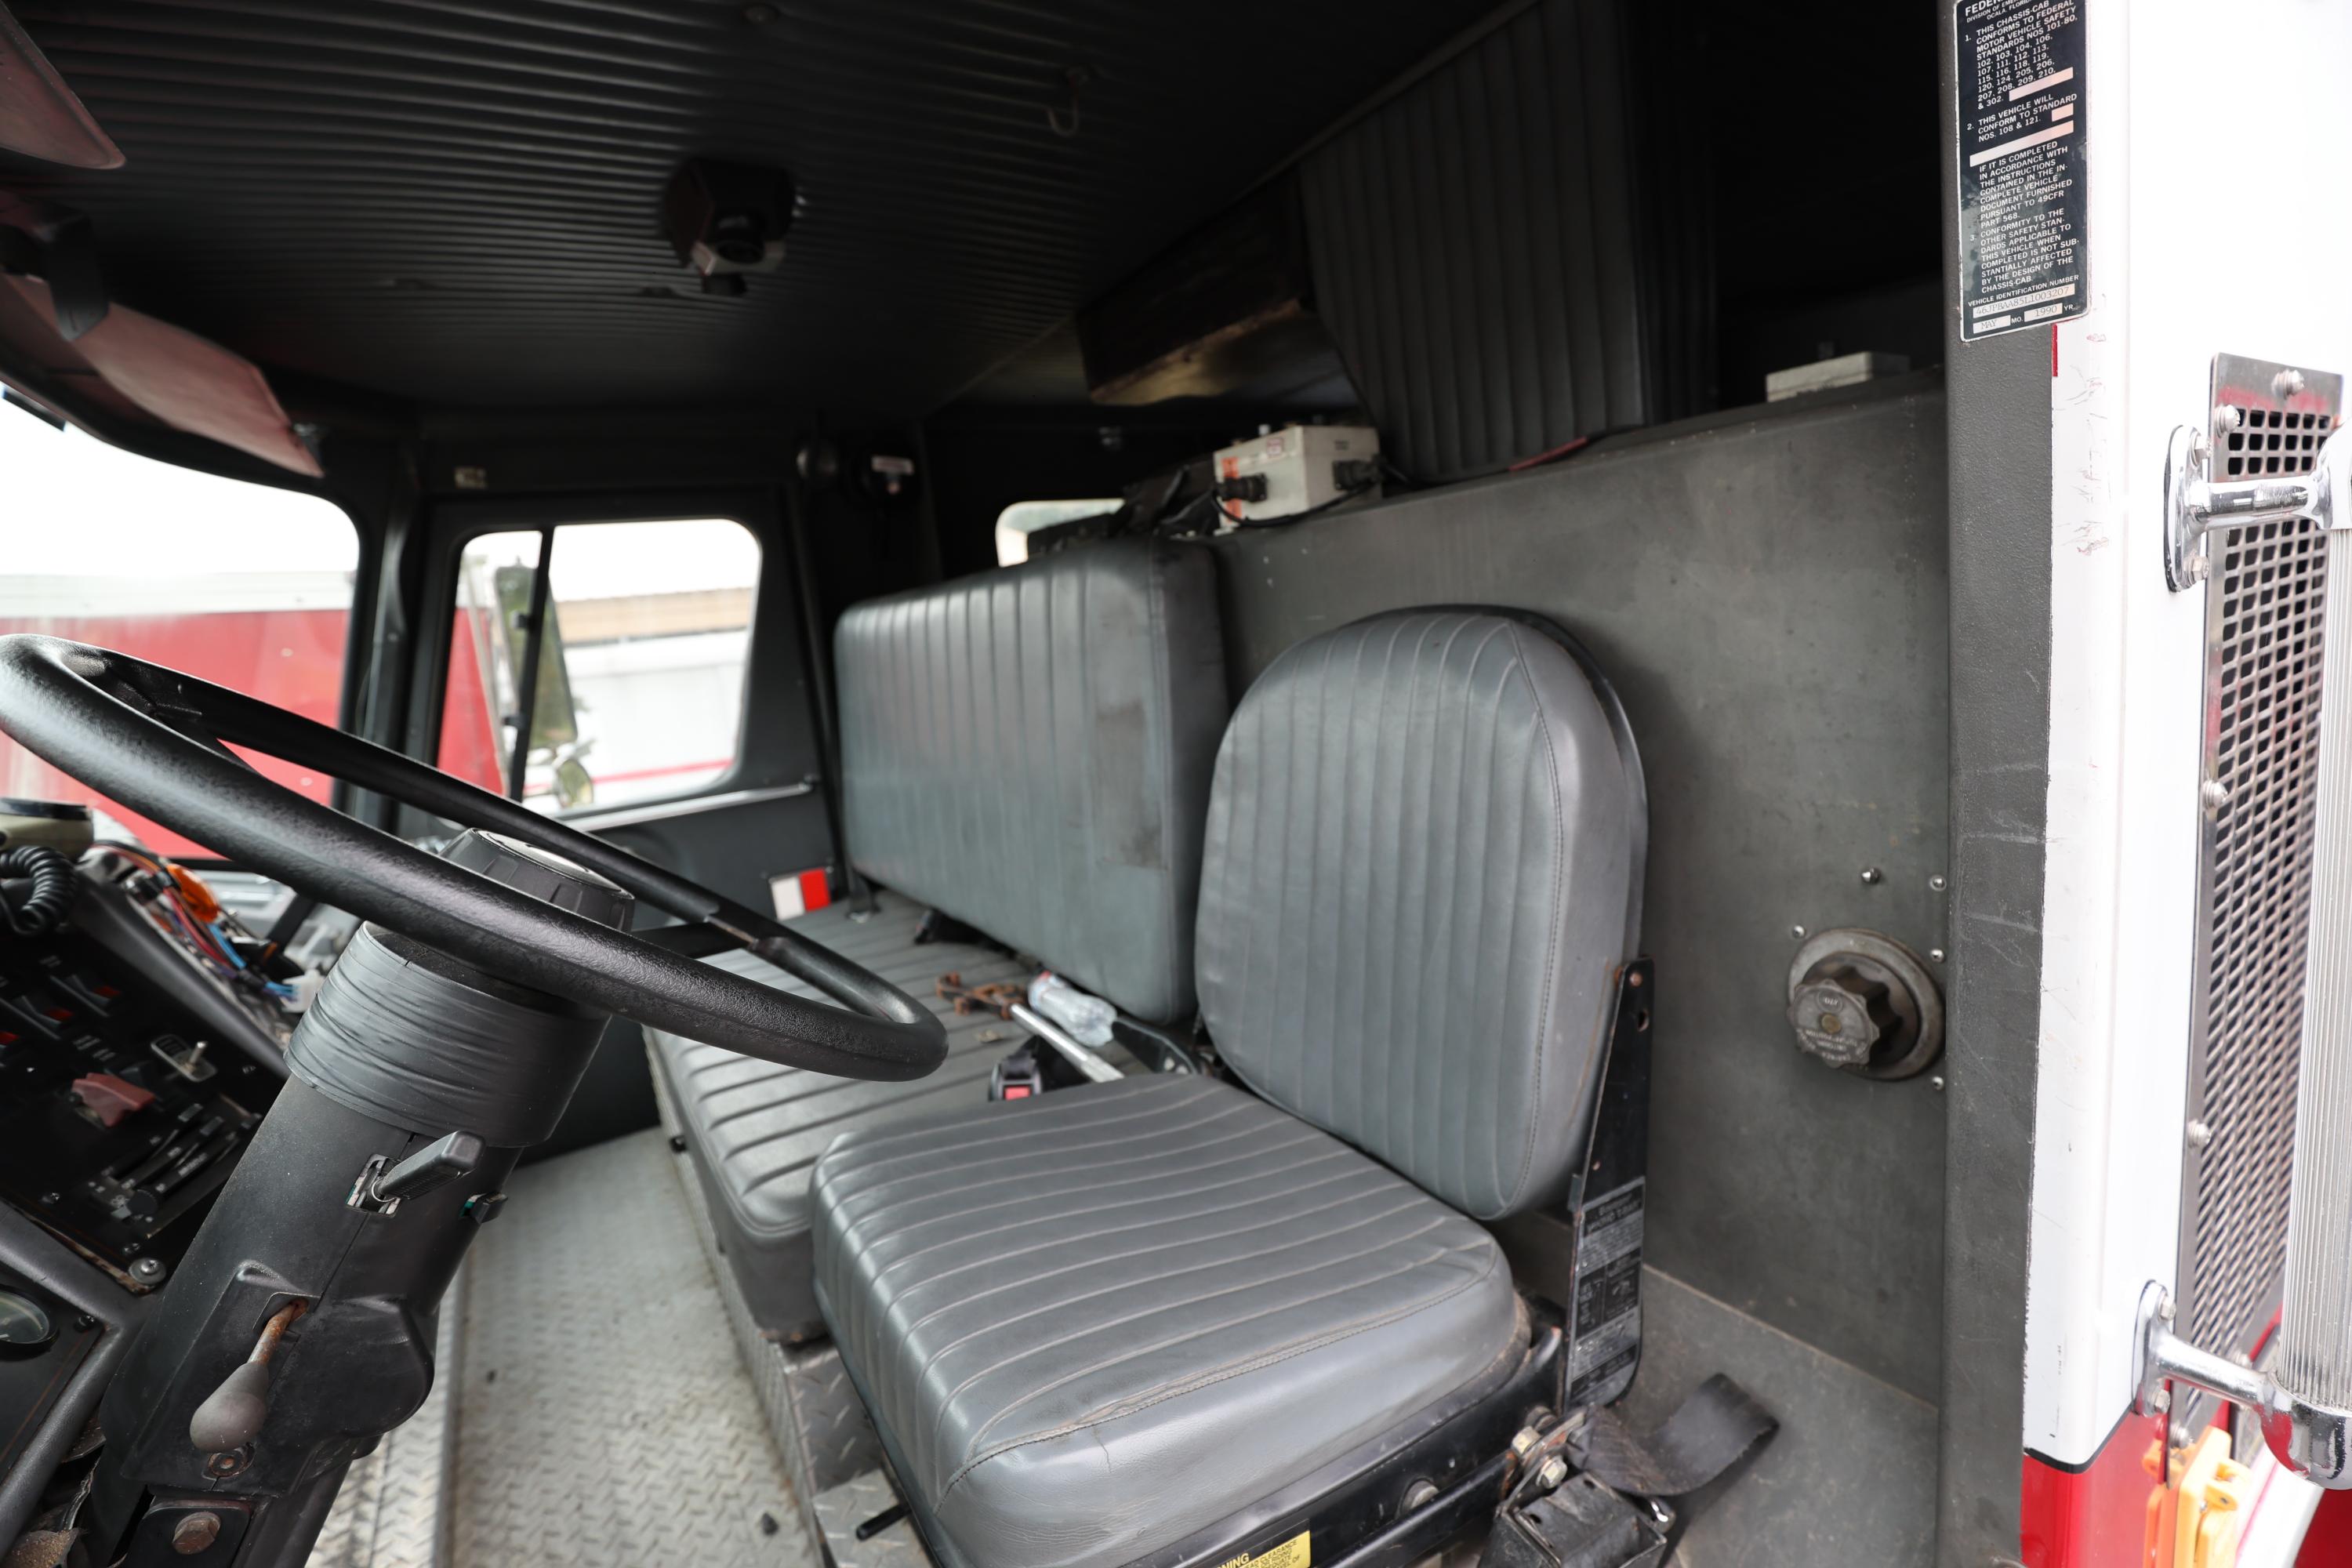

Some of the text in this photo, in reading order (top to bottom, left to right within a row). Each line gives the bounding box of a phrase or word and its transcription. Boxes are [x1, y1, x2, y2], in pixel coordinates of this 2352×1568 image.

[1967, 9, 1991, 22] DIVISION
[1976, 24, 1994, 35] THIS
[1996, 0, 2049, 27] CHASSIS-CAB
[1976, 0, 2074, 44] CONFORMS TO FEDERAL
[1976, 5, 2075, 53] MOTOR VEHICLE SAFETY
[1977, 36, 2024, 60] STANDARDS
[2027, 27, 2043, 39] NOS
[1978, 115, 2016, 134] CONFORM
[2033, 93, 2077, 114] STANDARD
[1979, 114, 1995, 125] THIS
[1998, 101, 2031, 118] VEHICLE
[2034, 94, 2053, 105] WILL
[1987, 96, 2003, 106] 302.
[1999, 125, 2013, 135] 108
[2025, 116, 2040, 125] 121.
[1990, 154, 2043, 177] ACCORDANCE
[2046, 146, 2067, 158] WITH
[2009, 141, 2057, 162] COMPLETED
[1980, 159, 2056, 188] THE INSTRUCTIONS
[1980, 177, 2024, 195] CONTAINED
[2038, 168, 2053, 177] THE
[1980, 175, 2057, 204] COMPLETE VEHICLE
[1980, 179, 2072, 212] DOCUMENT FURNISHED
[1980, 203, 2021, 220] PURSUANT
[2037, 190, 2063, 202] 49CFR
[1980, 218, 2031, 237] CONFORMITY
[2048, 208, 2063, 217] THE
[1980, 234, 2006, 245] OTHER
[2009, 223, 2038, 238] SAFETY
[1981, 212, 2020, 228] PART 568.
[1981, 241, 2005, 253] DARDS
[2009, 227, 2056, 245] APPLICABLE
[1981, 234, 2060, 261] THIS VEHICLE WHEN
[1981, 252, 2027, 269] COMPLETED
[2041, 243, 2057, 252] NOT
[1982, 248, 2071, 277] STANTIALLY AFFECTED
[1994, 273, 2009, 281] THE
[2012, 264, 2040, 277] DESIGN
[2056, 256, 2073, 265] THE
[1968, 274, 2078, 306] VEHICLE IDENTIFICATION NUMBER
[1981, 319, 1997, 328] MAY
[2035, 306, 2056, 317] 1990
